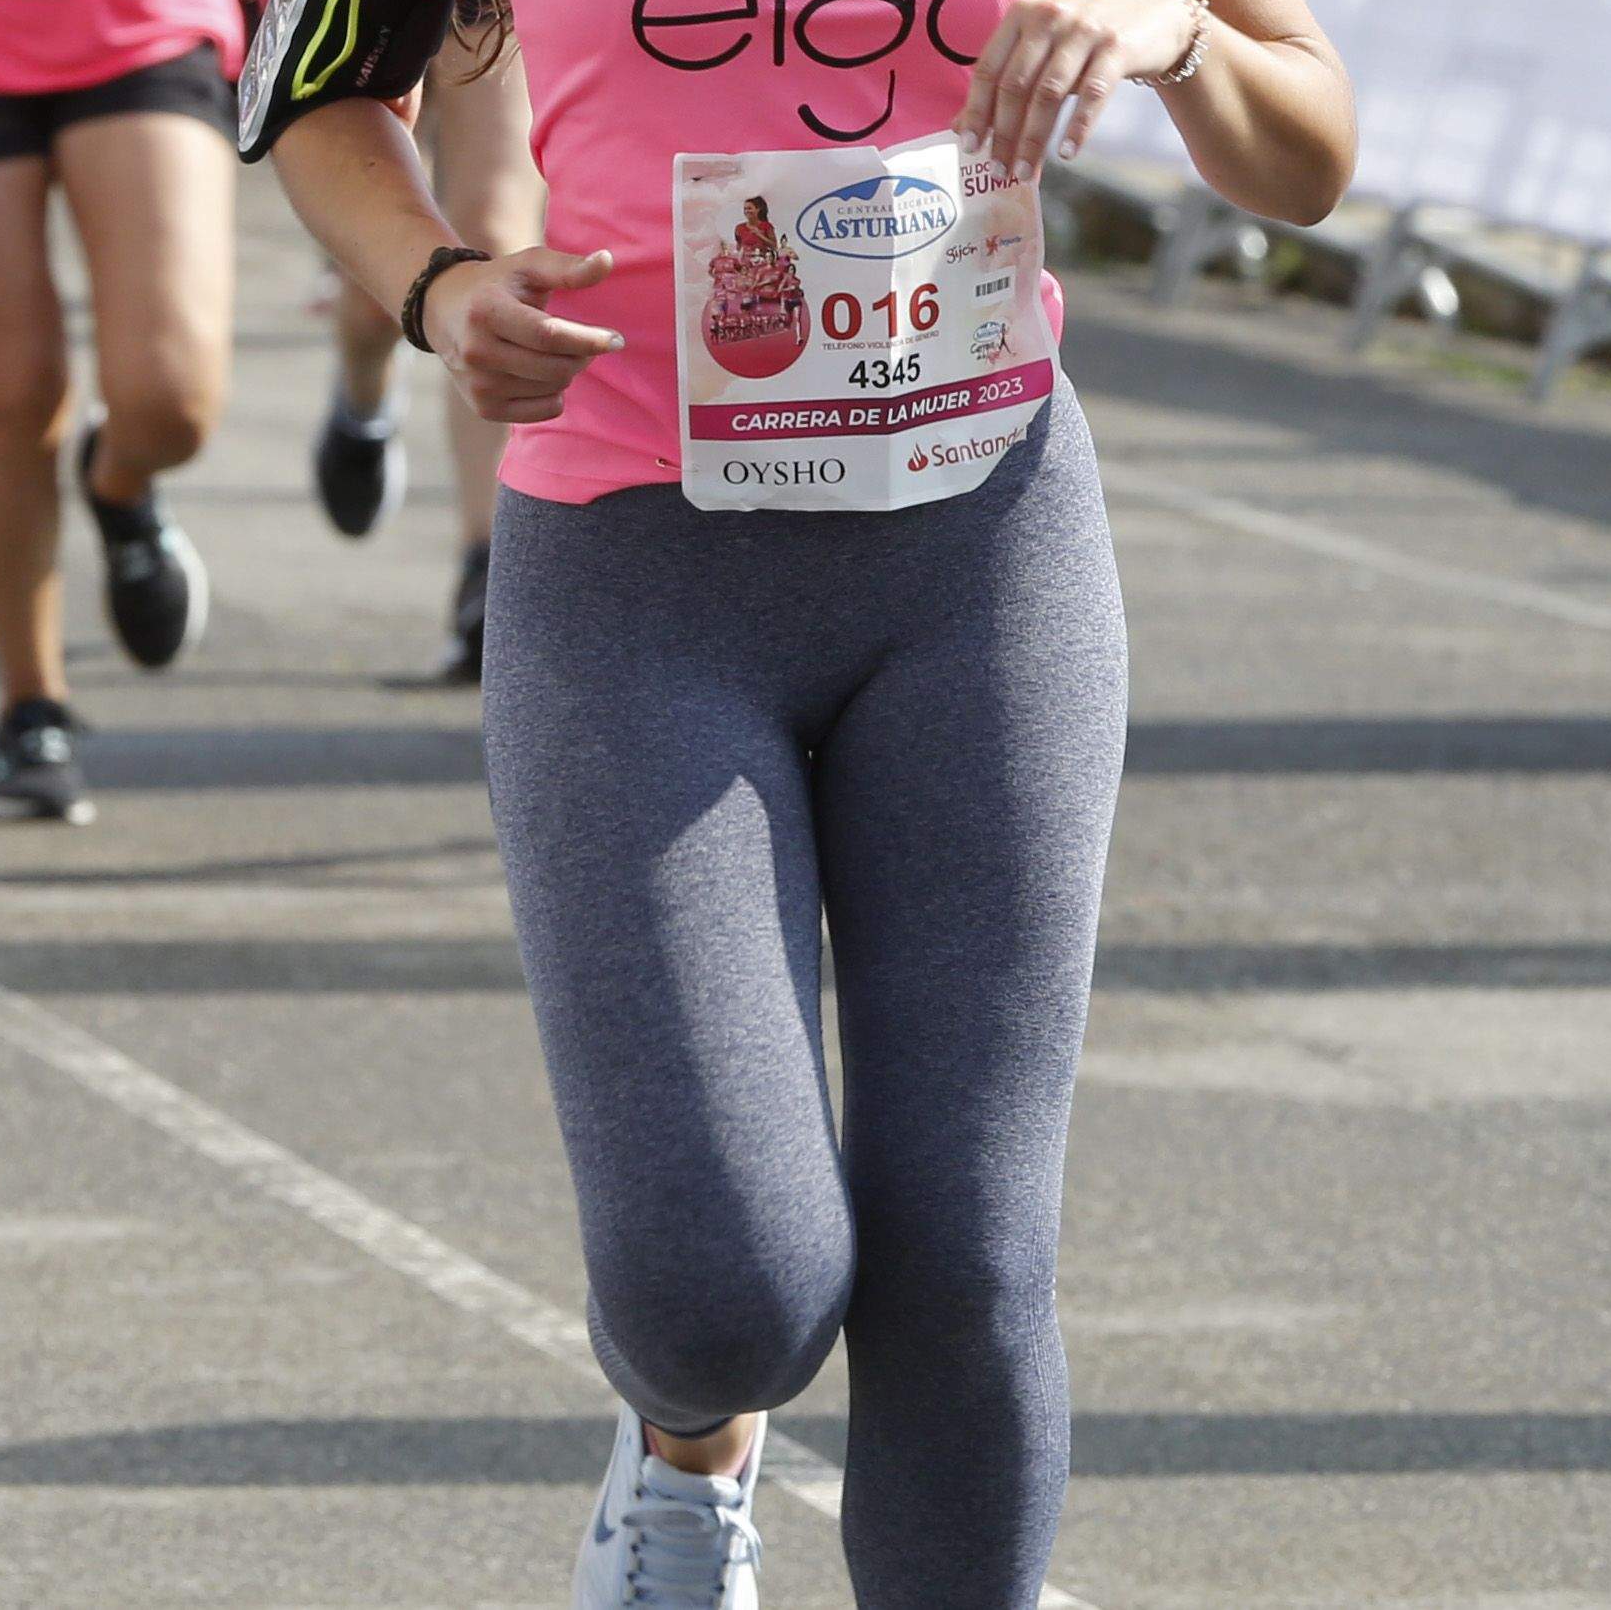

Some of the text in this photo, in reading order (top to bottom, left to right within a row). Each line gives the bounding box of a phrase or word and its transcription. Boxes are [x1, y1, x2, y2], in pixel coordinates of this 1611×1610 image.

[961, 165, 973, 177] TU
[810, 207, 948, 240] ASTURIANA
[837, 204, 894, 215] CENTRAL
[946, 242, 978, 264] gijón
[821, 283, 939, 341] 016
[848, 352, 921, 389] 4345
[731, 376, 1024, 432] CARRERA DE LA MUJER 2023
[723, 458, 846, 486] OYSHO
